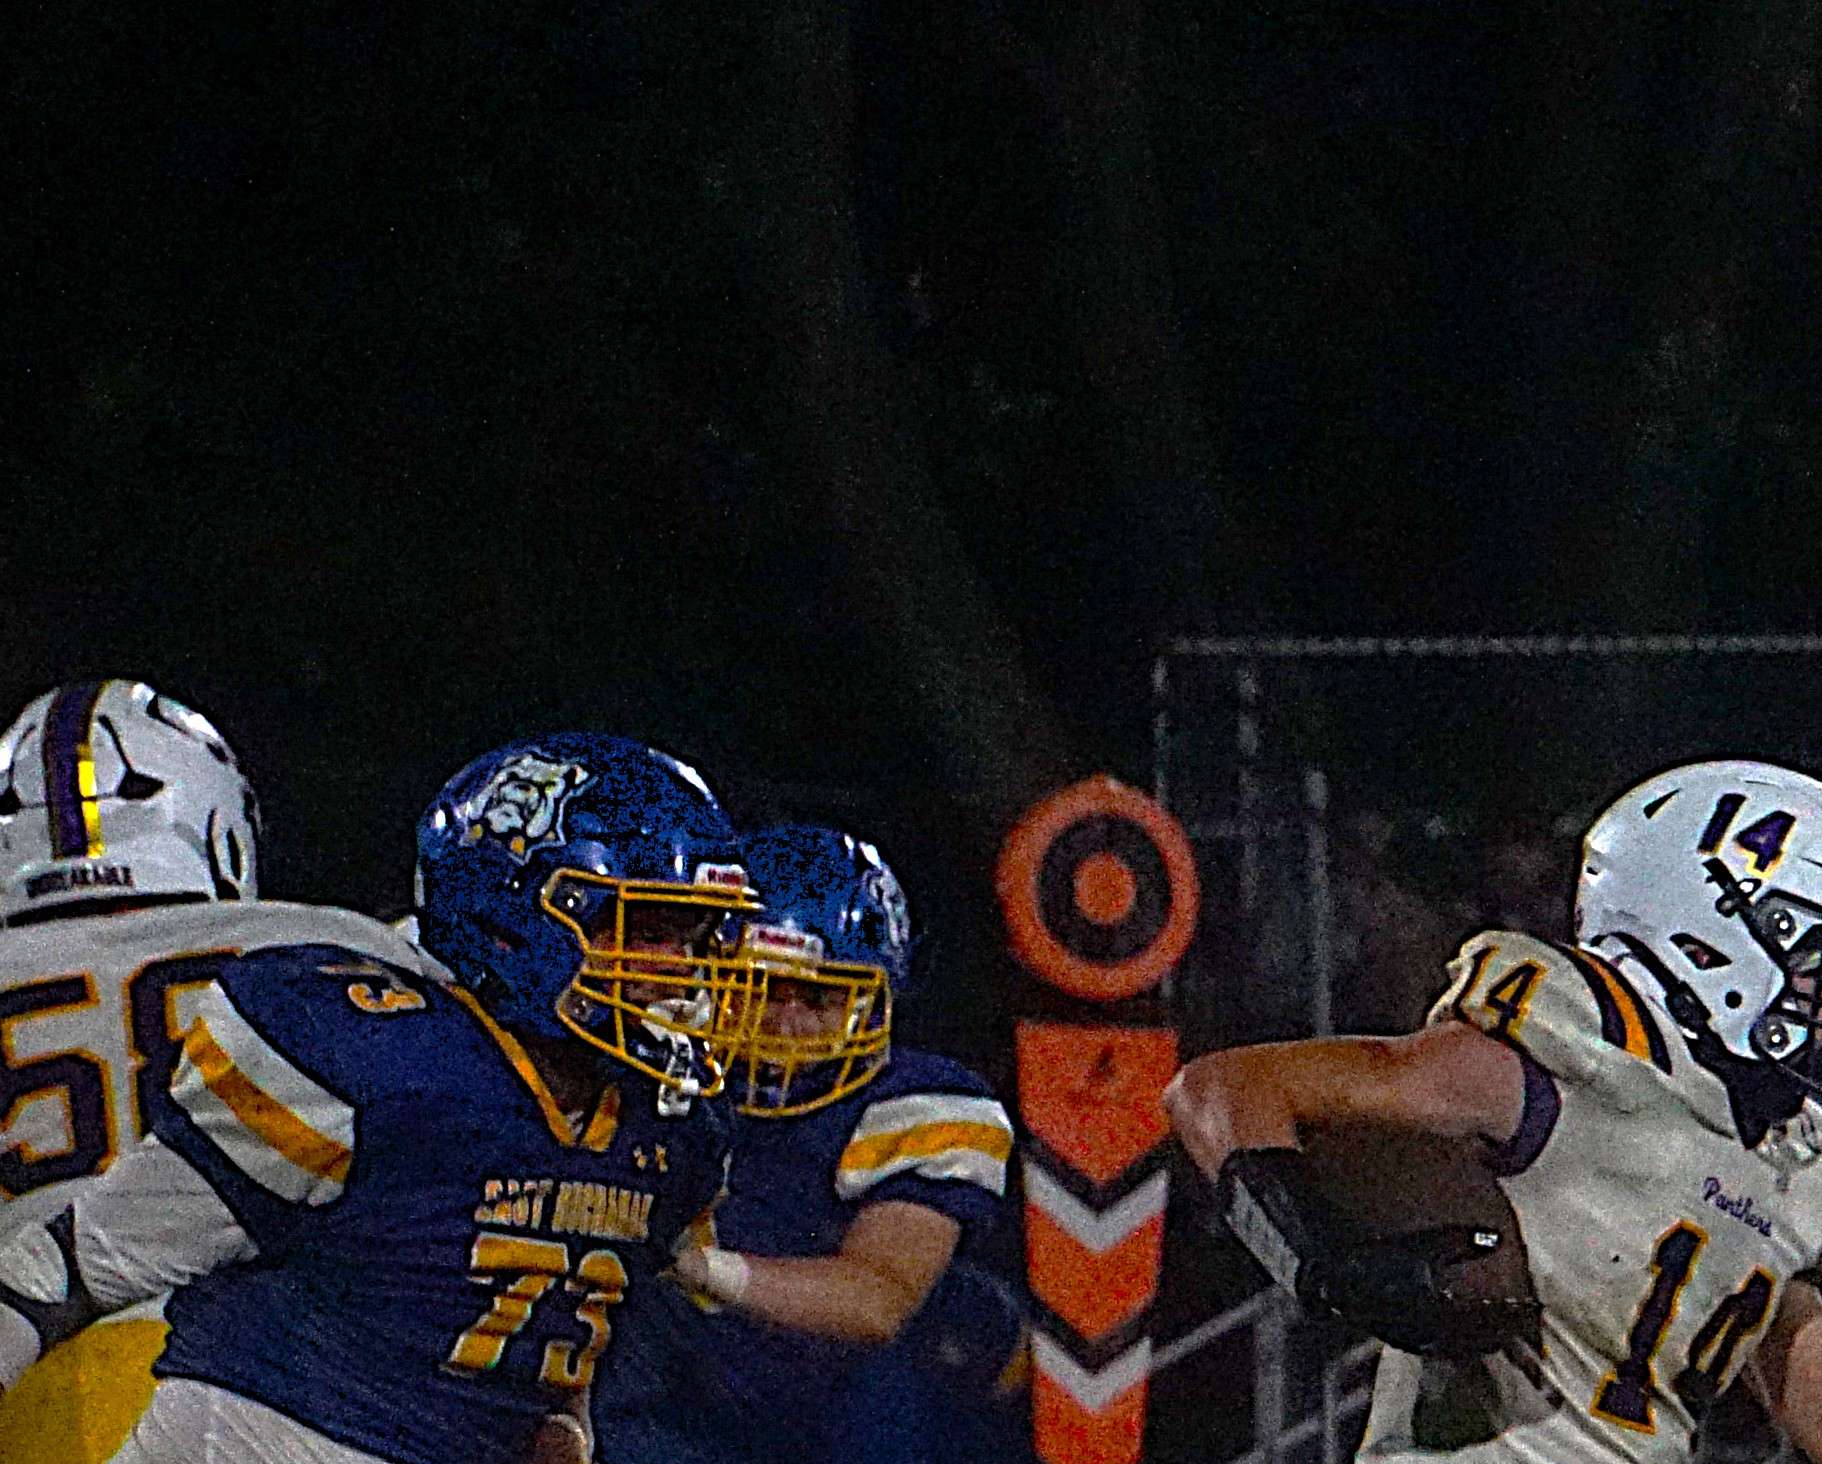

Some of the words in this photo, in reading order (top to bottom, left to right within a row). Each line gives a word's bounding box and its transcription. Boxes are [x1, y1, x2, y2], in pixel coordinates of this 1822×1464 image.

[1697, 793, 1798, 880] 14
[1451, 944, 1553, 1043] 14
[440, 1231, 629, 1390] 73
[1589, 1219, 1778, 1436] 14
